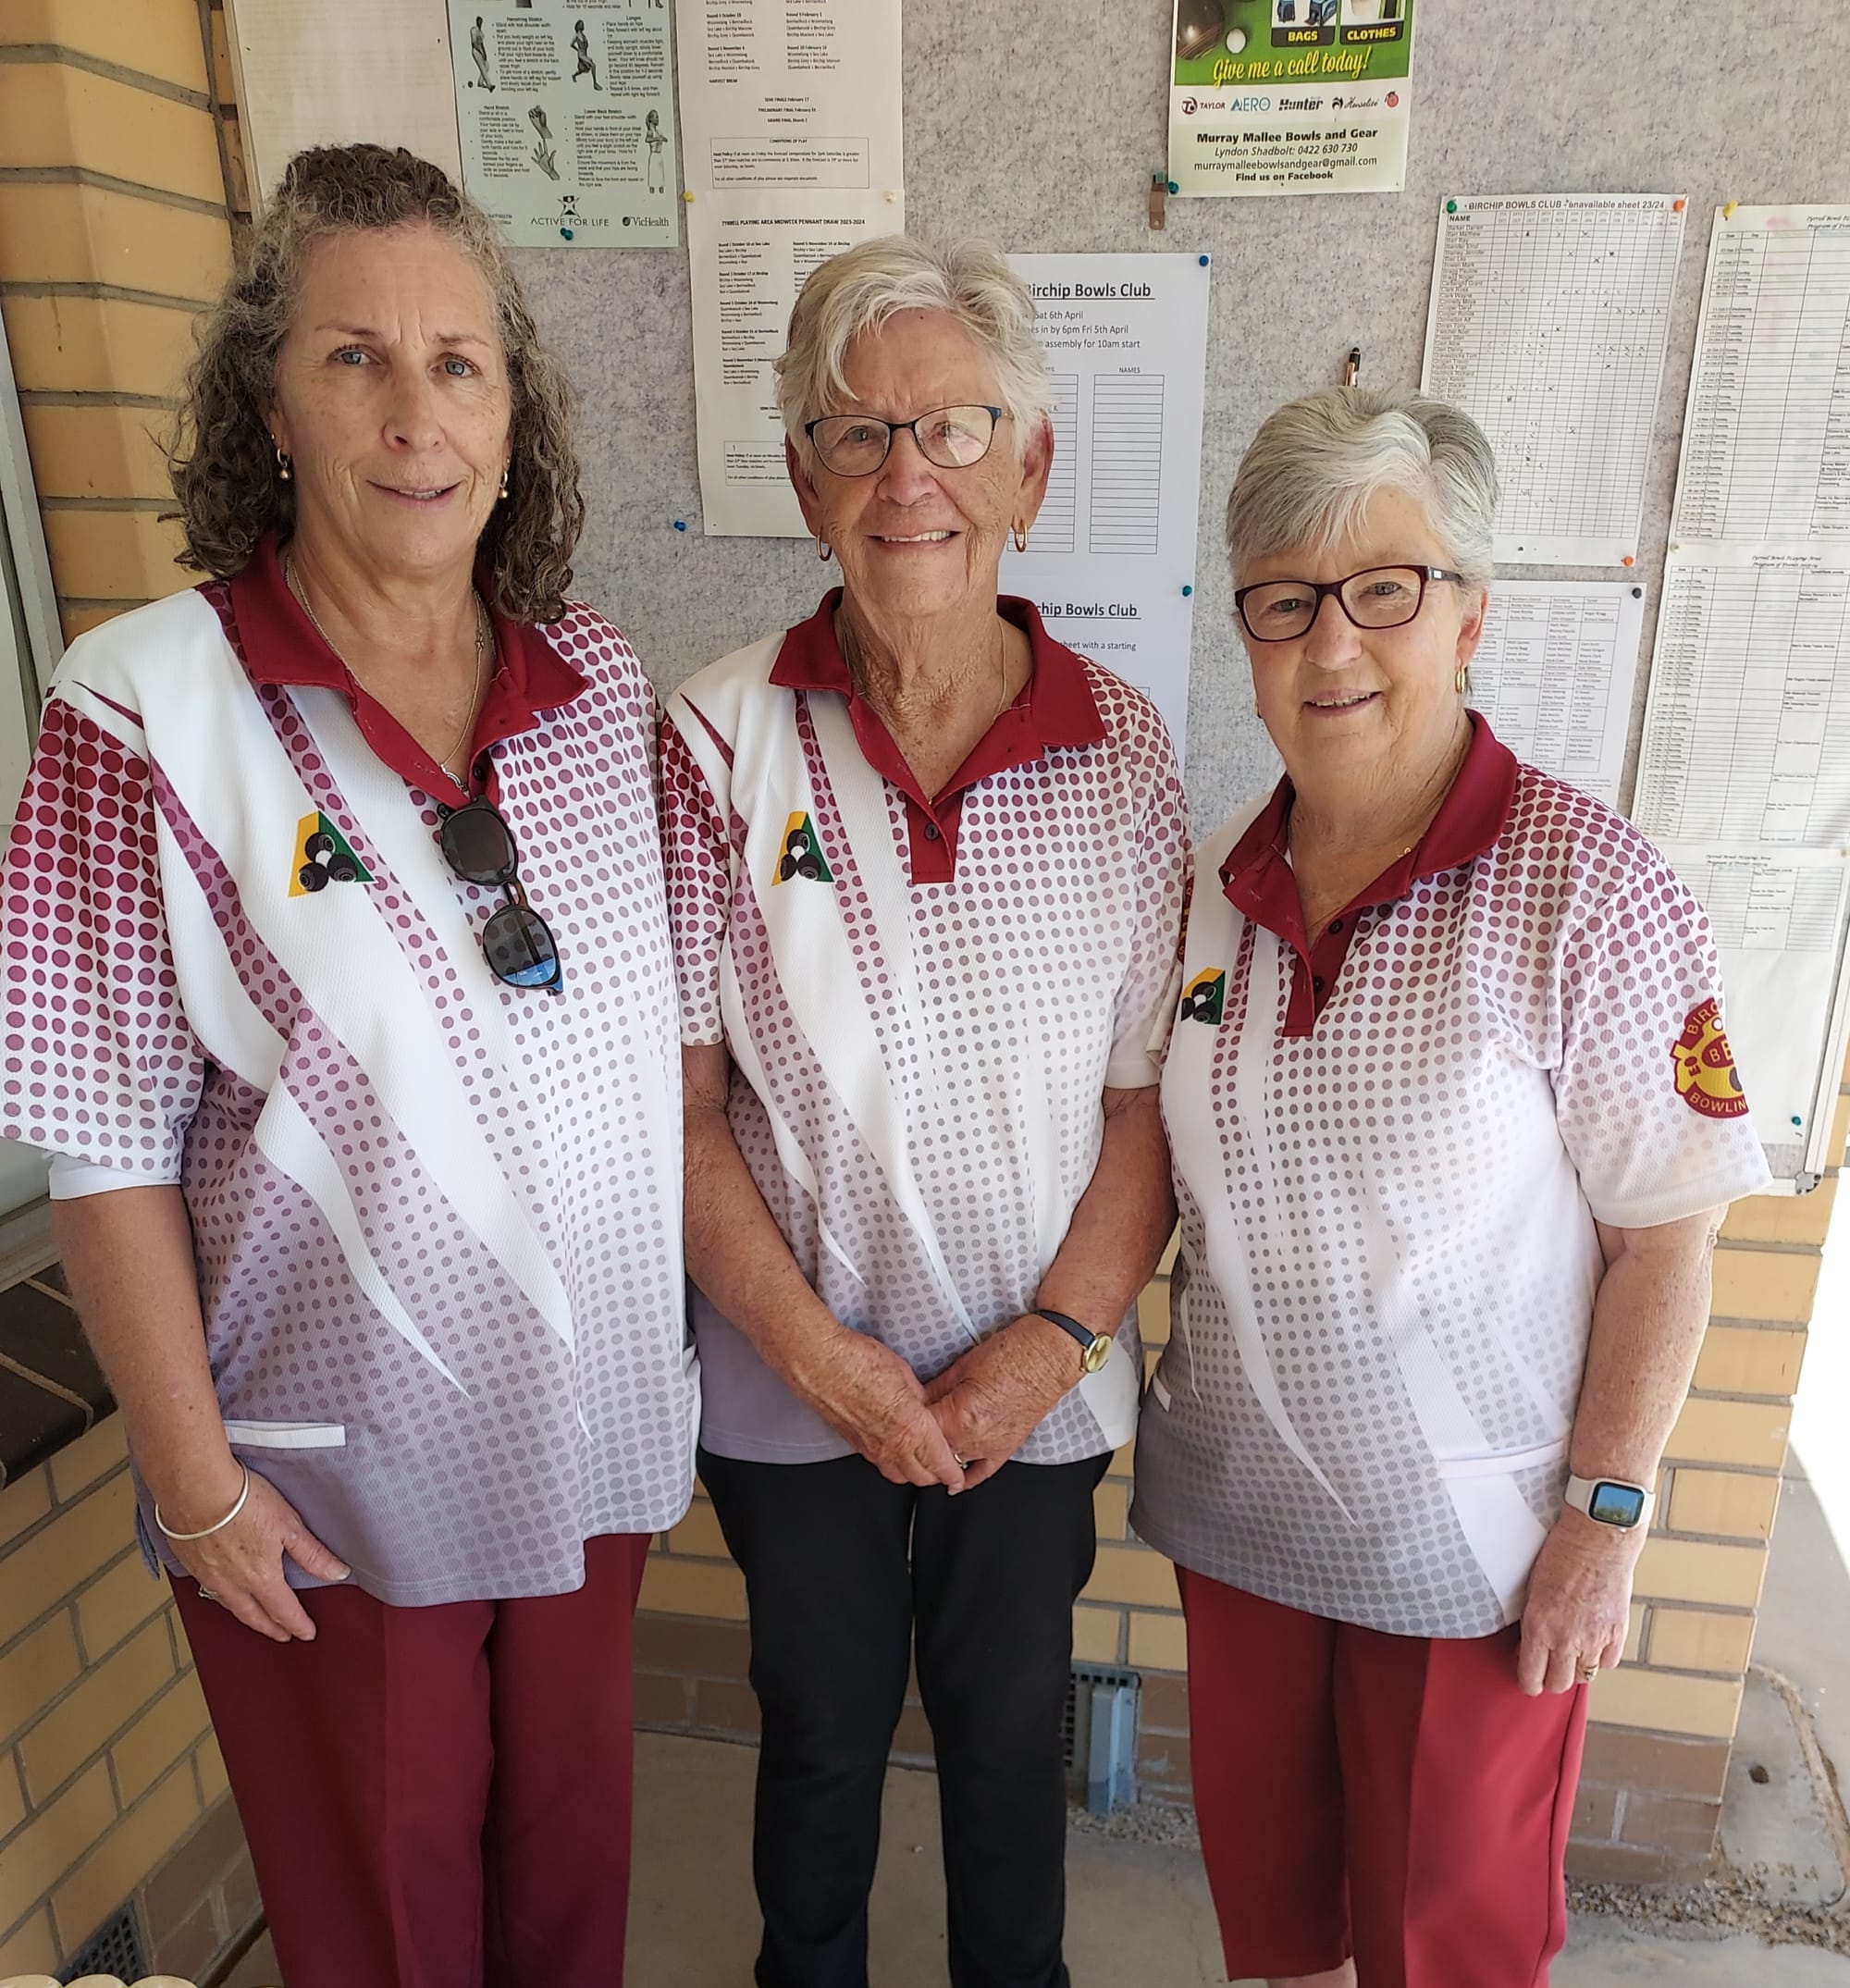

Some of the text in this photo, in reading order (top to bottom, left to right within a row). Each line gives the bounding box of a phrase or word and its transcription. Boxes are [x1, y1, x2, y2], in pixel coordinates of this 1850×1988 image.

[1288, 31, 1318, 42] BAGS
[1347, 27, 1397, 41] CLOTHES
[1213, 46, 1372, 87] Give me a call today!
[1200, 102, 1226, 110] TAYLOR
[1230, 97, 1271, 112] AERO
[1278, 98, 1324, 111] Hunter
[1197, 129, 1377, 144] Murray Mallee Bowls and Gear
[1215, 142, 1358, 158] Lyndon Shadbolt: 0422 630 730
[1194, 156, 1377, 171] murraymalleebowlsandgear@gmail.com
[1236, 173, 1256, 181] Find
[1288, 171, 1333, 180] Facebook
[1469, 202, 1504, 210] BIRCHIP
[1508, 201, 1536, 209] BOWLS
[1642, 201, 1664, 209] 23/24
[531, 217, 609, 227] ACTIVE FOR LIFE
[633, 216, 669, 227] VicHealth
[1075, 282, 1116, 297] Bowls
[1120, 282, 1151, 297] Club
[1049, 311, 1063, 319] 6th
[1065, 311, 1083, 321] April
[1041, 326, 1048, 334] in
[1050, 326, 1060, 335] by
[1062, 326, 1080, 335] 6pm
[1082, 326, 1092, 334] Fri
[1094, 326, 1108, 334] 5th
[1109, 326, 1128, 335] April
[1045, 340, 1082, 350] assembly
[1083, 339, 1095, 348] for
[1098, 340, 1119, 348] 10am
[1036, 602, 1137, 617] chip Bowls Club
[1061, 640, 1080, 648] heet
[1082, 640, 1099, 648] with
[1107, 642, 1136, 651] starting
[1686, 1002, 1719, 1035] BIRC
[1690, 1092, 1746, 1114] BOWLIN
